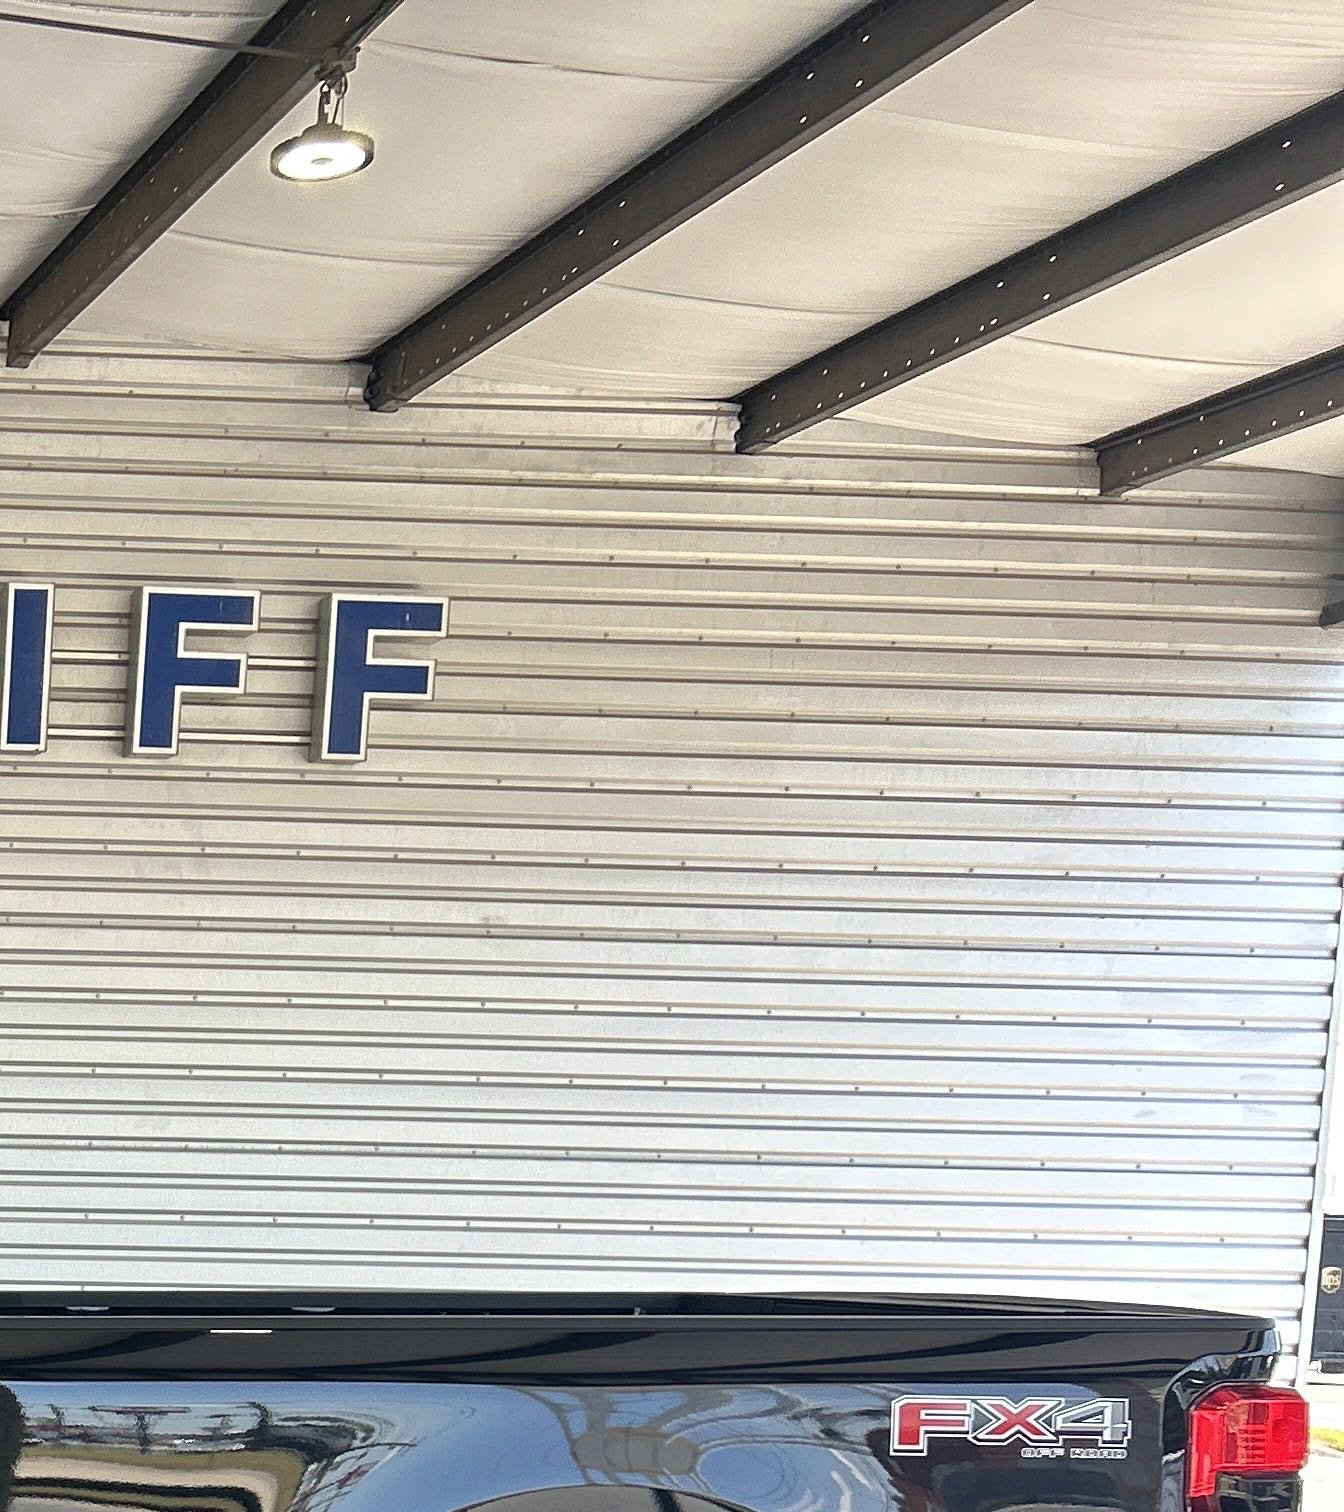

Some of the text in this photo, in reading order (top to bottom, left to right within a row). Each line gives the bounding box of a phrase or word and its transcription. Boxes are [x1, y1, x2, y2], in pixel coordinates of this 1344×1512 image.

[890, 1395, 1131, 1456] FX4
[1020, 1447, 1128, 1459] OFF ROAD
